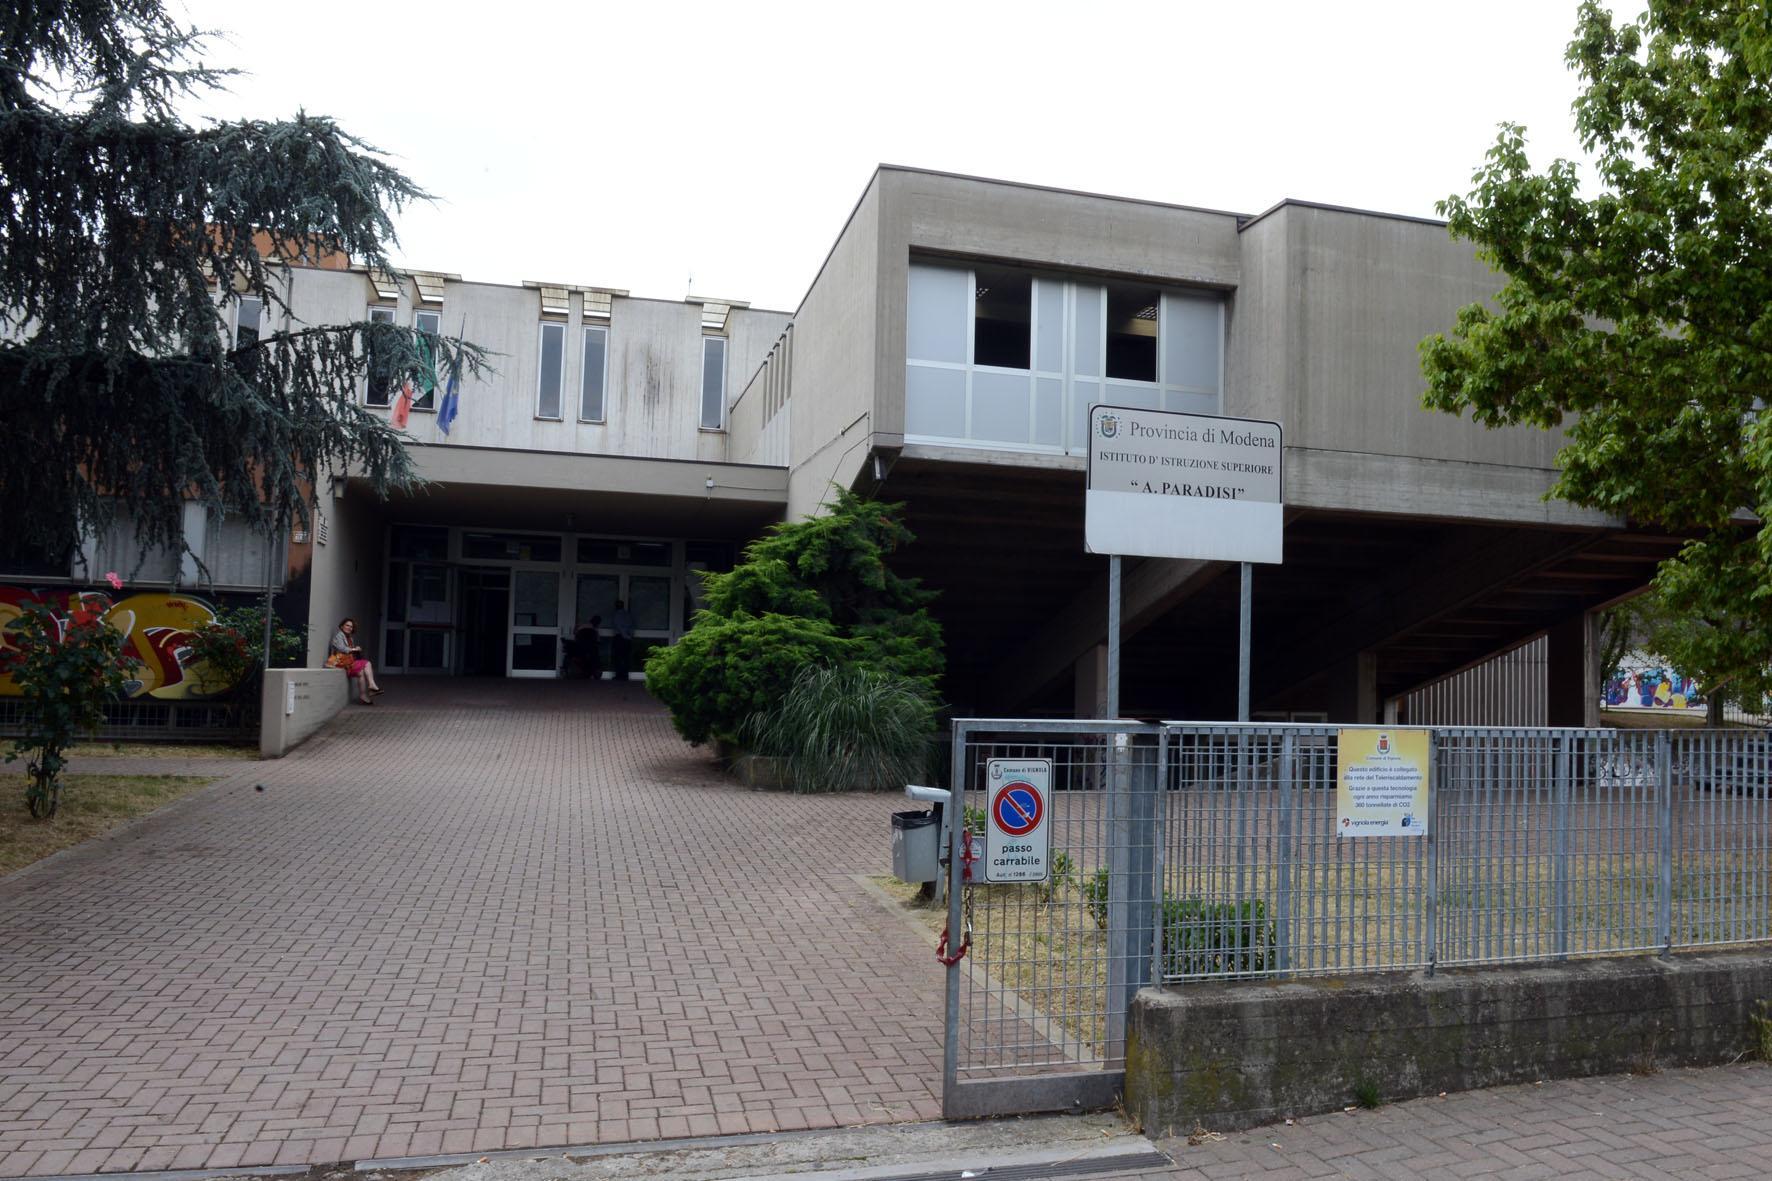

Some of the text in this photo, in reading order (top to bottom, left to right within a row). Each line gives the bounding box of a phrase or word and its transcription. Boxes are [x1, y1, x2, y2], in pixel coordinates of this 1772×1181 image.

[1130, 421, 1276, 448] Provincia di Modena
[1100, 450, 1146, 464] ISTITUTO
[1161, 458, 1219, 470] ISTRUZIONE
[1221, 461, 1274, 475] SUPERIORE
[1002, 845, 1032, 854] passo
[994, 856, 1040, 866] carrabile
